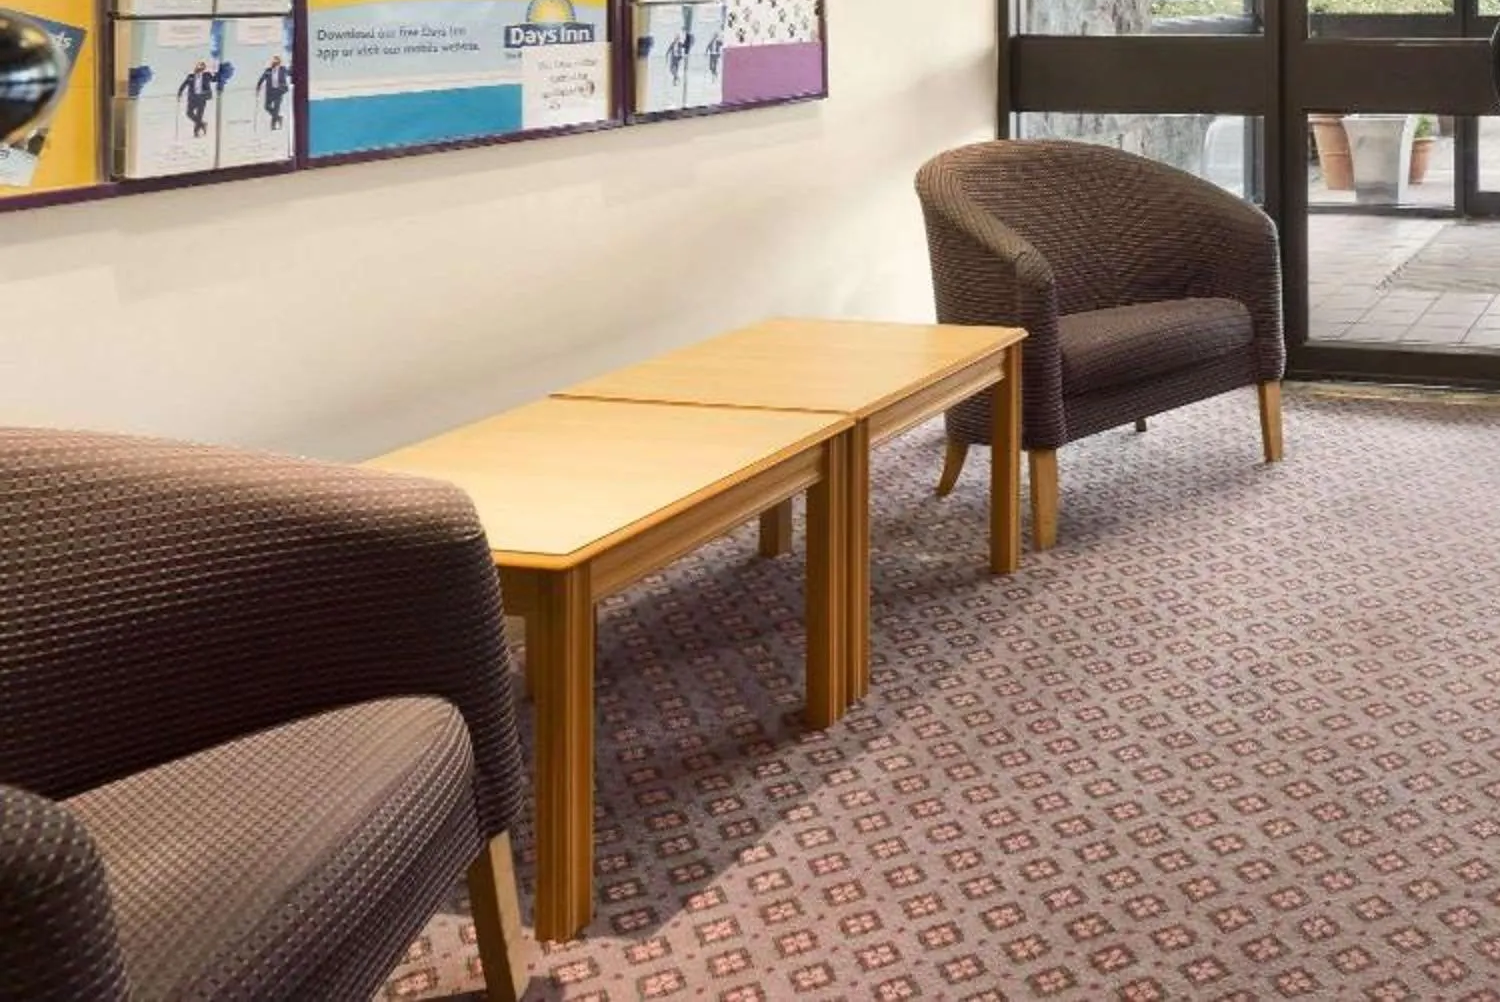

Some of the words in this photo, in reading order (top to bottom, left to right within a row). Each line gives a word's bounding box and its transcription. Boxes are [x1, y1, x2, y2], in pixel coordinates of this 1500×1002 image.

[317, 26, 374, 40] Download
[510, 27, 557, 46] Days
[560, 27, 592, 43] Inn
